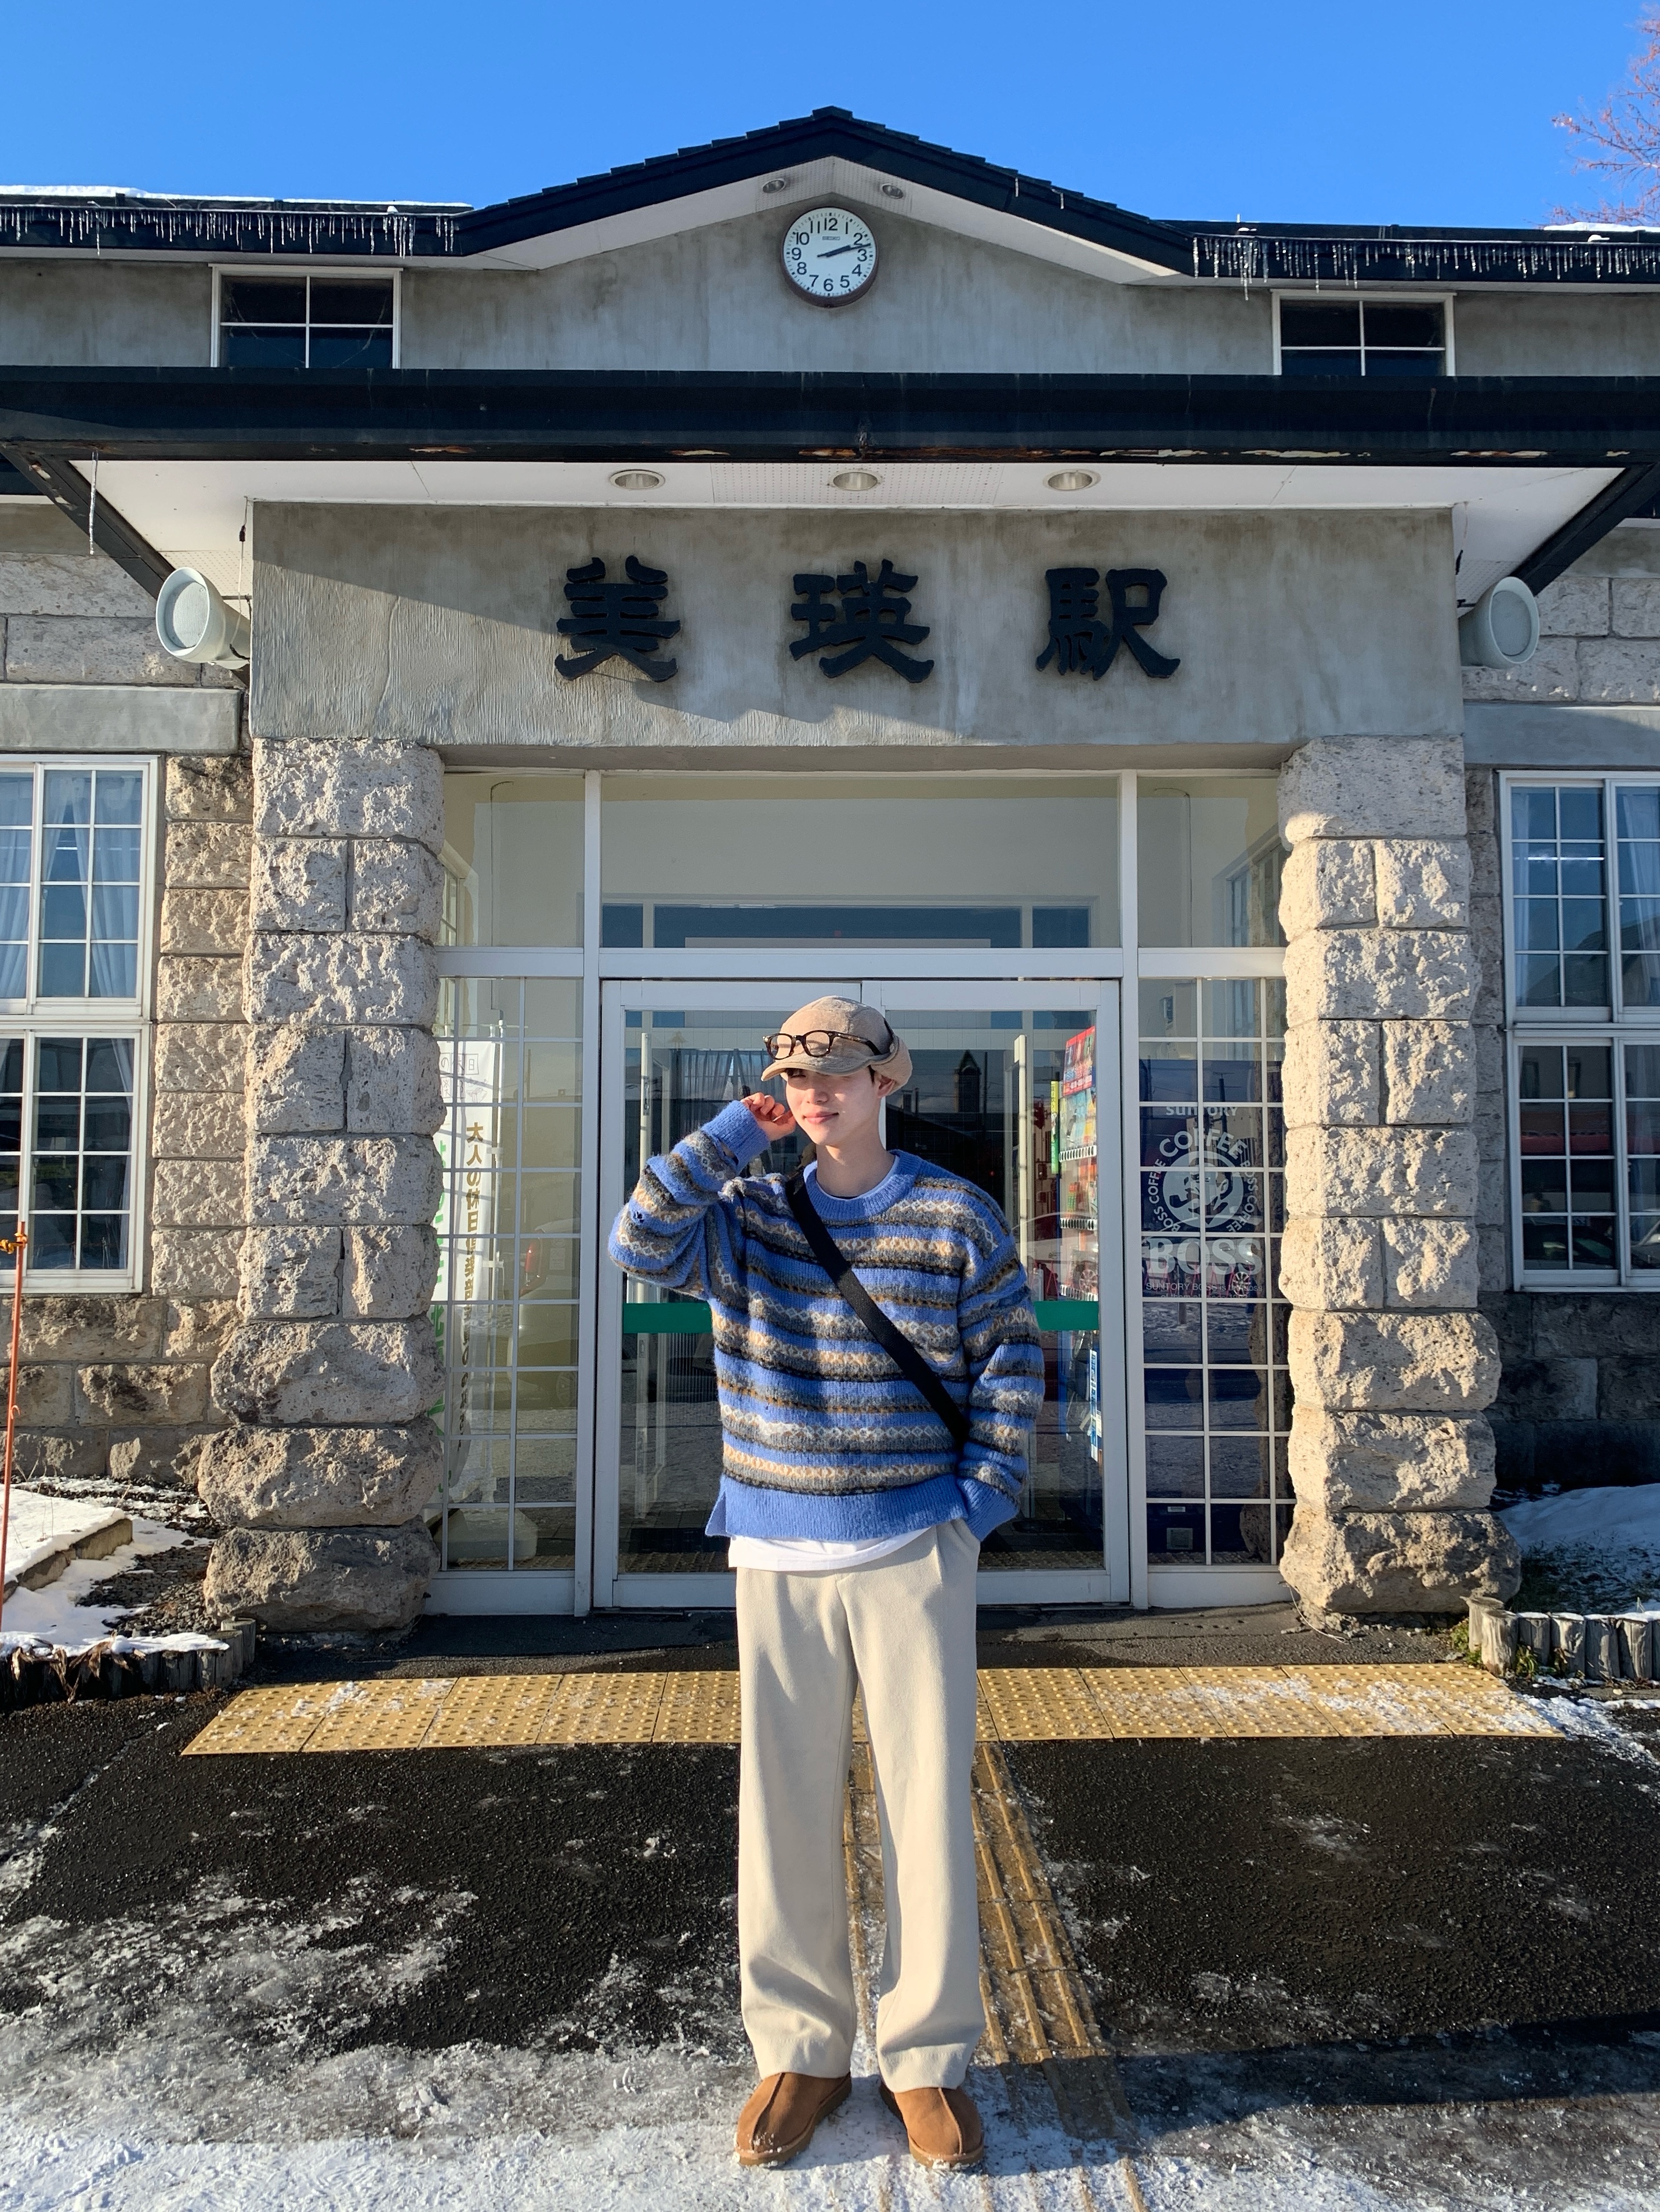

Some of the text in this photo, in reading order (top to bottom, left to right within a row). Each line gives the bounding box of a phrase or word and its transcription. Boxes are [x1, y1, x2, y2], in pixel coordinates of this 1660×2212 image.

[810, 220, 820, 234] 11
[824, 217, 838, 231] 12
[796, 232, 810, 245] 10
[853, 233, 863, 246] 2
[791, 247, 802, 260] 9
[857, 248, 868, 262] 3
[796, 262, 807, 275] 8
[851, 264, 862, 277] 4
[809, 274, 819, 287] 7
[824, 278, 833, 292] 6
[840, 275, 850, 288] 5
[554, 555, 1181, 684] 美瑛駅
[1159, 1127, 1248, 1159] COFFEE
[1147, 1237, 1263, 1275] BOSS
